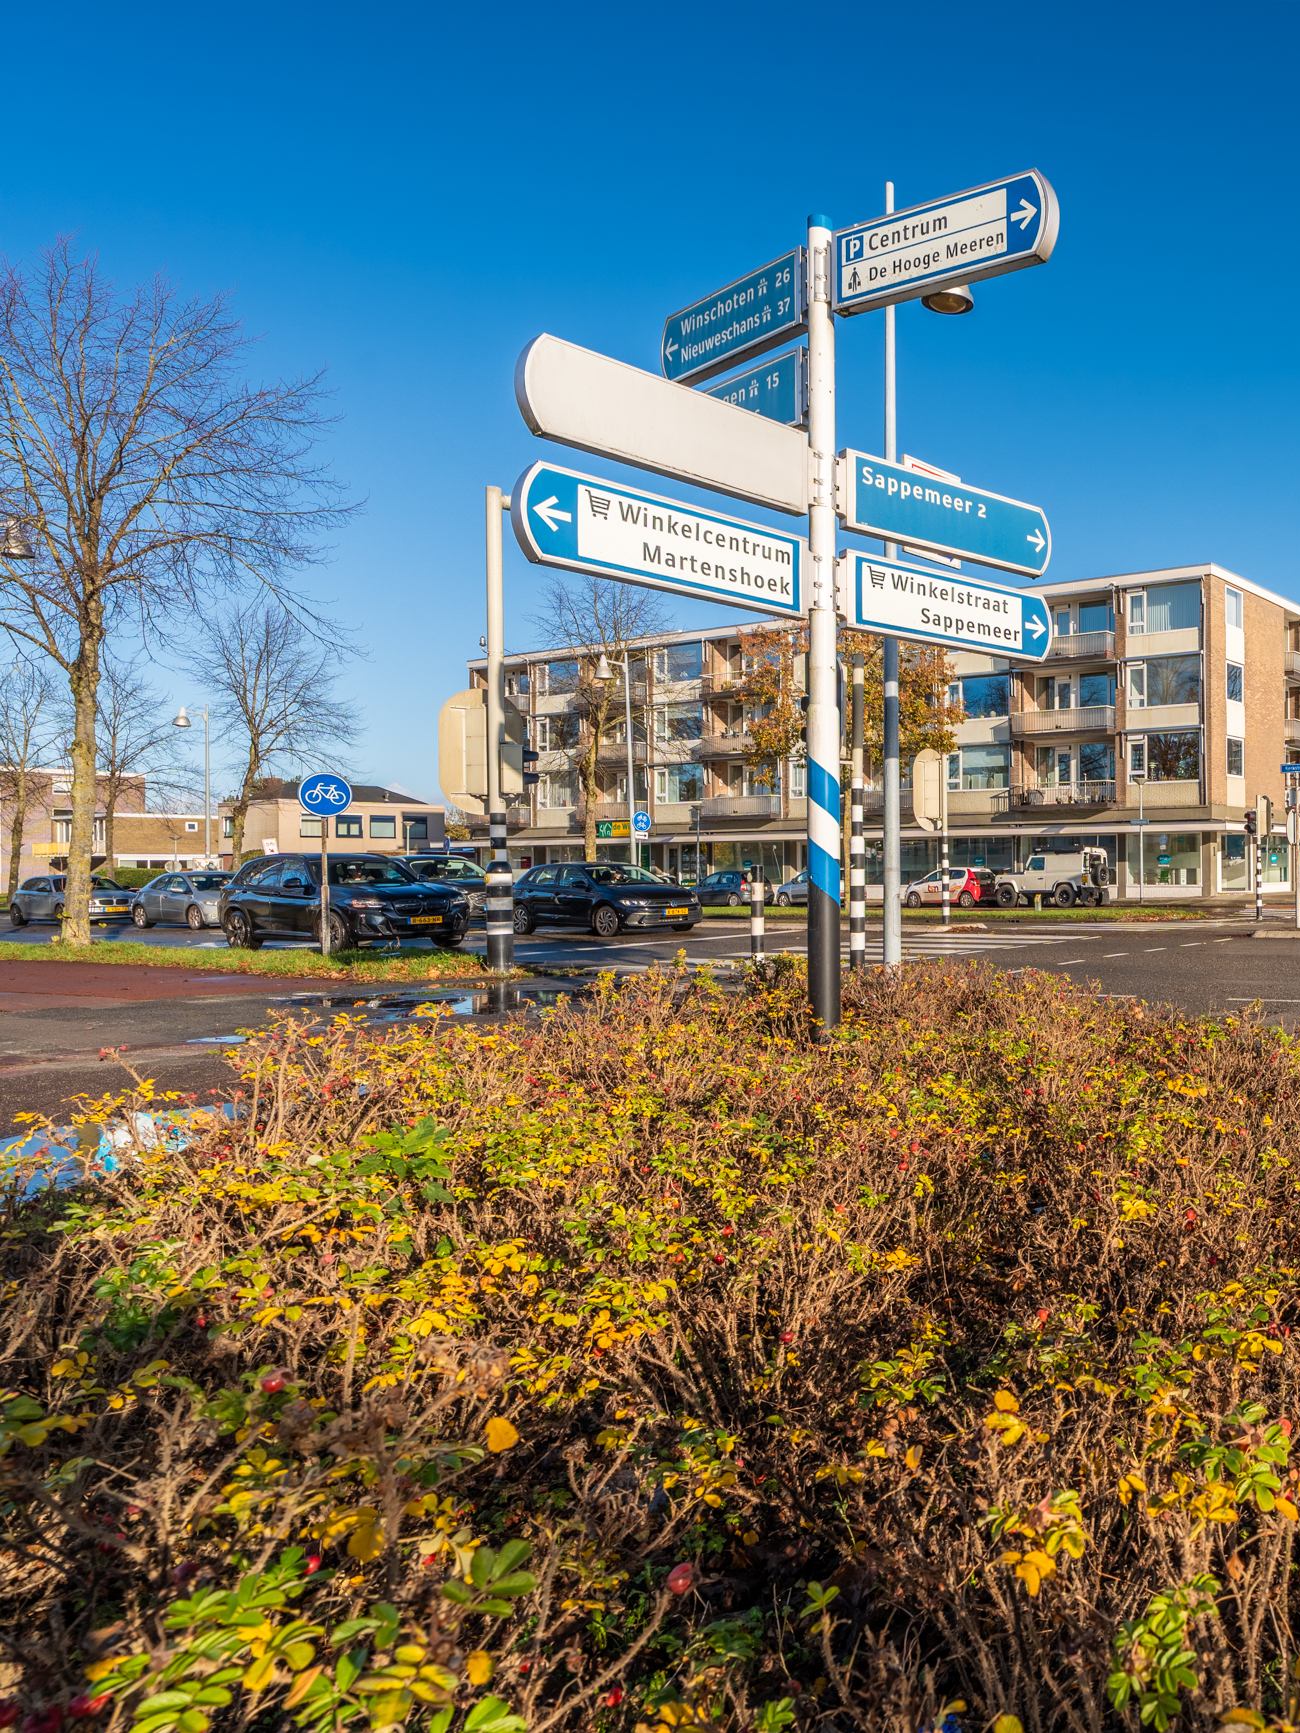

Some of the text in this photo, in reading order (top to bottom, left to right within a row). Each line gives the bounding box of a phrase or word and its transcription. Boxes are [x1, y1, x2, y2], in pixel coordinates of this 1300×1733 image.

[849, 214, 948, 259] P Centrum
[869, 230, 1004, 281] De Hooge Meeren
[680, 267, 791, 336] Winschoten 26
[680, 296, 791, 363] Nieuweschans 37
[766, 371, 780, 390] 15
[861, 466, 987, 519] Sappemeer 2
[618, 500, 791, 566] Winkelcentrum
[642, 541, 791, 596] Martenshoek
[890, 572, 1009, 614] Winkelstraat
[920, 607, 1021, 642] Sappemeer
